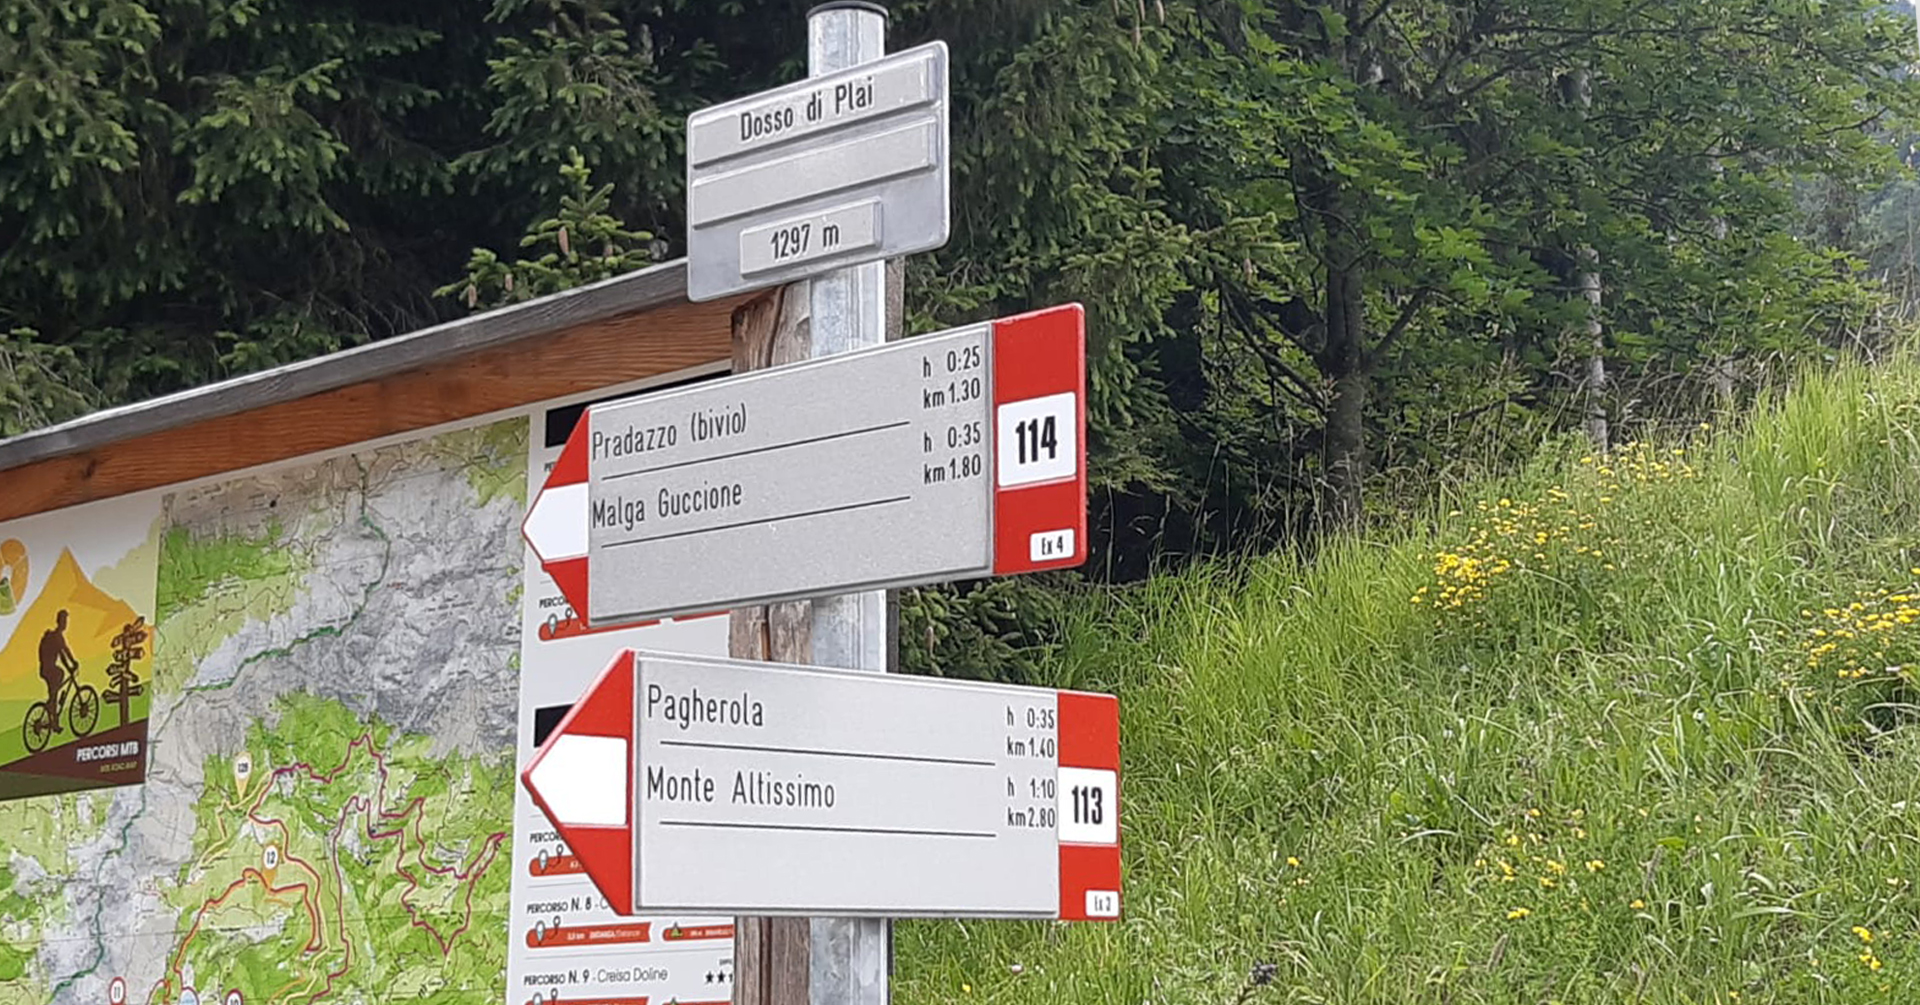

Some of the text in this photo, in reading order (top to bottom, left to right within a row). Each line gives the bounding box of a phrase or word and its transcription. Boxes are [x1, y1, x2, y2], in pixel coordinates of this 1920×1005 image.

[740, 76, 873, 141] Dosso di Plai
[771, 223, 839, 259] 1297 m
[923, 345, 980, 378] h 0:25
[923, 377, 981, 409] km 1.30
[592, 402, 747, 460] Pradazzo (bivio)
[924, 421, 981, 453] h 0:35
[1015, 415, 1058, 465] 114
[924, 453, 981, 485] km 1.80
[592, 480, 742, 532] Malga Guccione
[1041, 535, 1064, 555] Ex 4
[538, 596, 568, 609] PERCO
[648, 684, 763, 730] Pagherola
[1007, 706, 1055, 729] h 0:35
[76, 740, 139, 762] PERCORSI MTB
[1007, 736, 1055, 758] km 1.40
[647, 765, 835, 808] Monte Altissimo
[1007, 777, 1055, 799] h 1:10
[1007, 807, 1056, 828] km 2.80
[1071, 785, 1103, 825] 113
[266, 851, 275, 864] 12
[526, 901, 568, 914] PERCORSO
[571, 897, 582, 911] N.
[524, 973, 566, 985] PERCORSO
[568, 970, 580, 983] N.
[582, 970, 590, 982] 9
[633, 967, 668, 982] Doline
